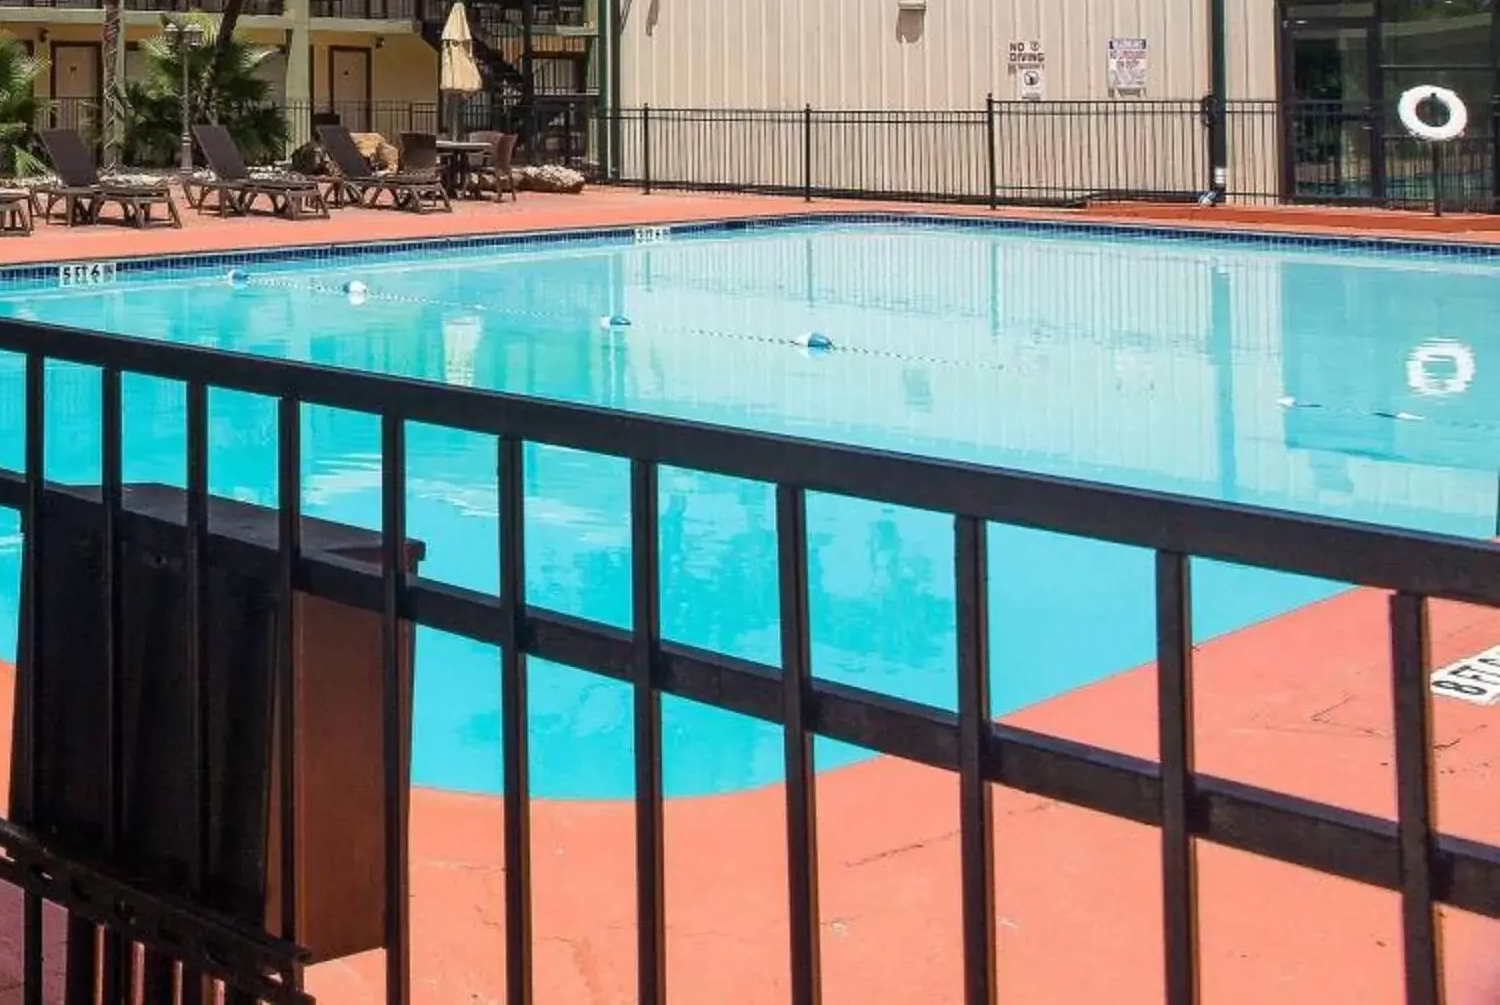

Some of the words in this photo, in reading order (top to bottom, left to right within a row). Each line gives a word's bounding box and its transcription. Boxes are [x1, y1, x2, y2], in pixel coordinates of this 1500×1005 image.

[1009, 42, 1025, 52] NO
[1009, 52, 1045, 62] DIVING
[91, 264, 101, 276] 6
[1431, 680, 1488, 696] 8
